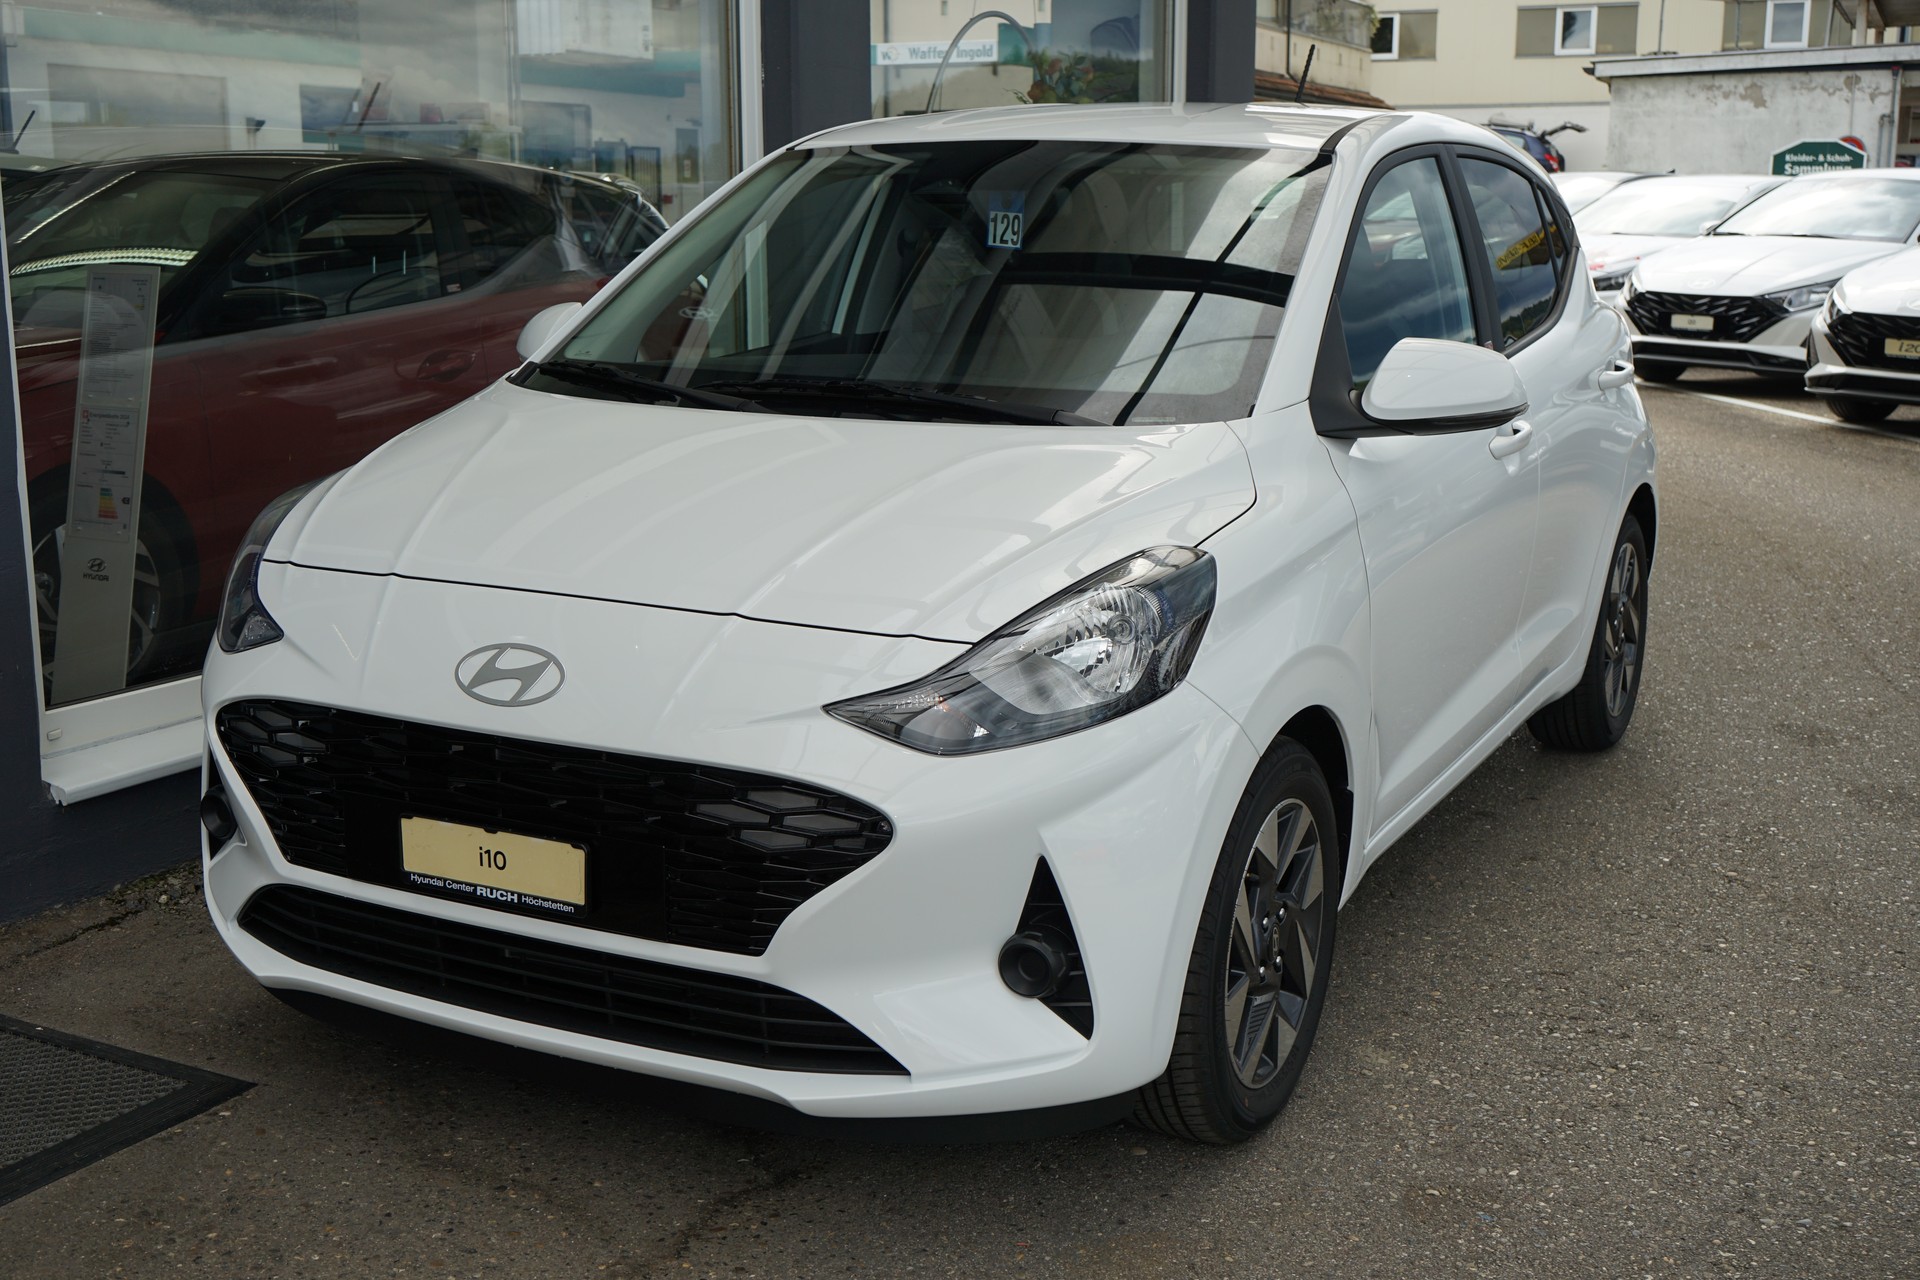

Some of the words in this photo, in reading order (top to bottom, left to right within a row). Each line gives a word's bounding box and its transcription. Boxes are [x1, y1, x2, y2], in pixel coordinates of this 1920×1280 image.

[908, 46, 949, 60] Waffe
[990, 212, 1021, 246] 129
[479, 846, 507, 871] i10
[410, 873, 444, 887] Hyundai
[445, 880, 475, 893] Center
[476, 886, 518, 903] RUCH
[521, 895, 575, 913] Höchstetten
